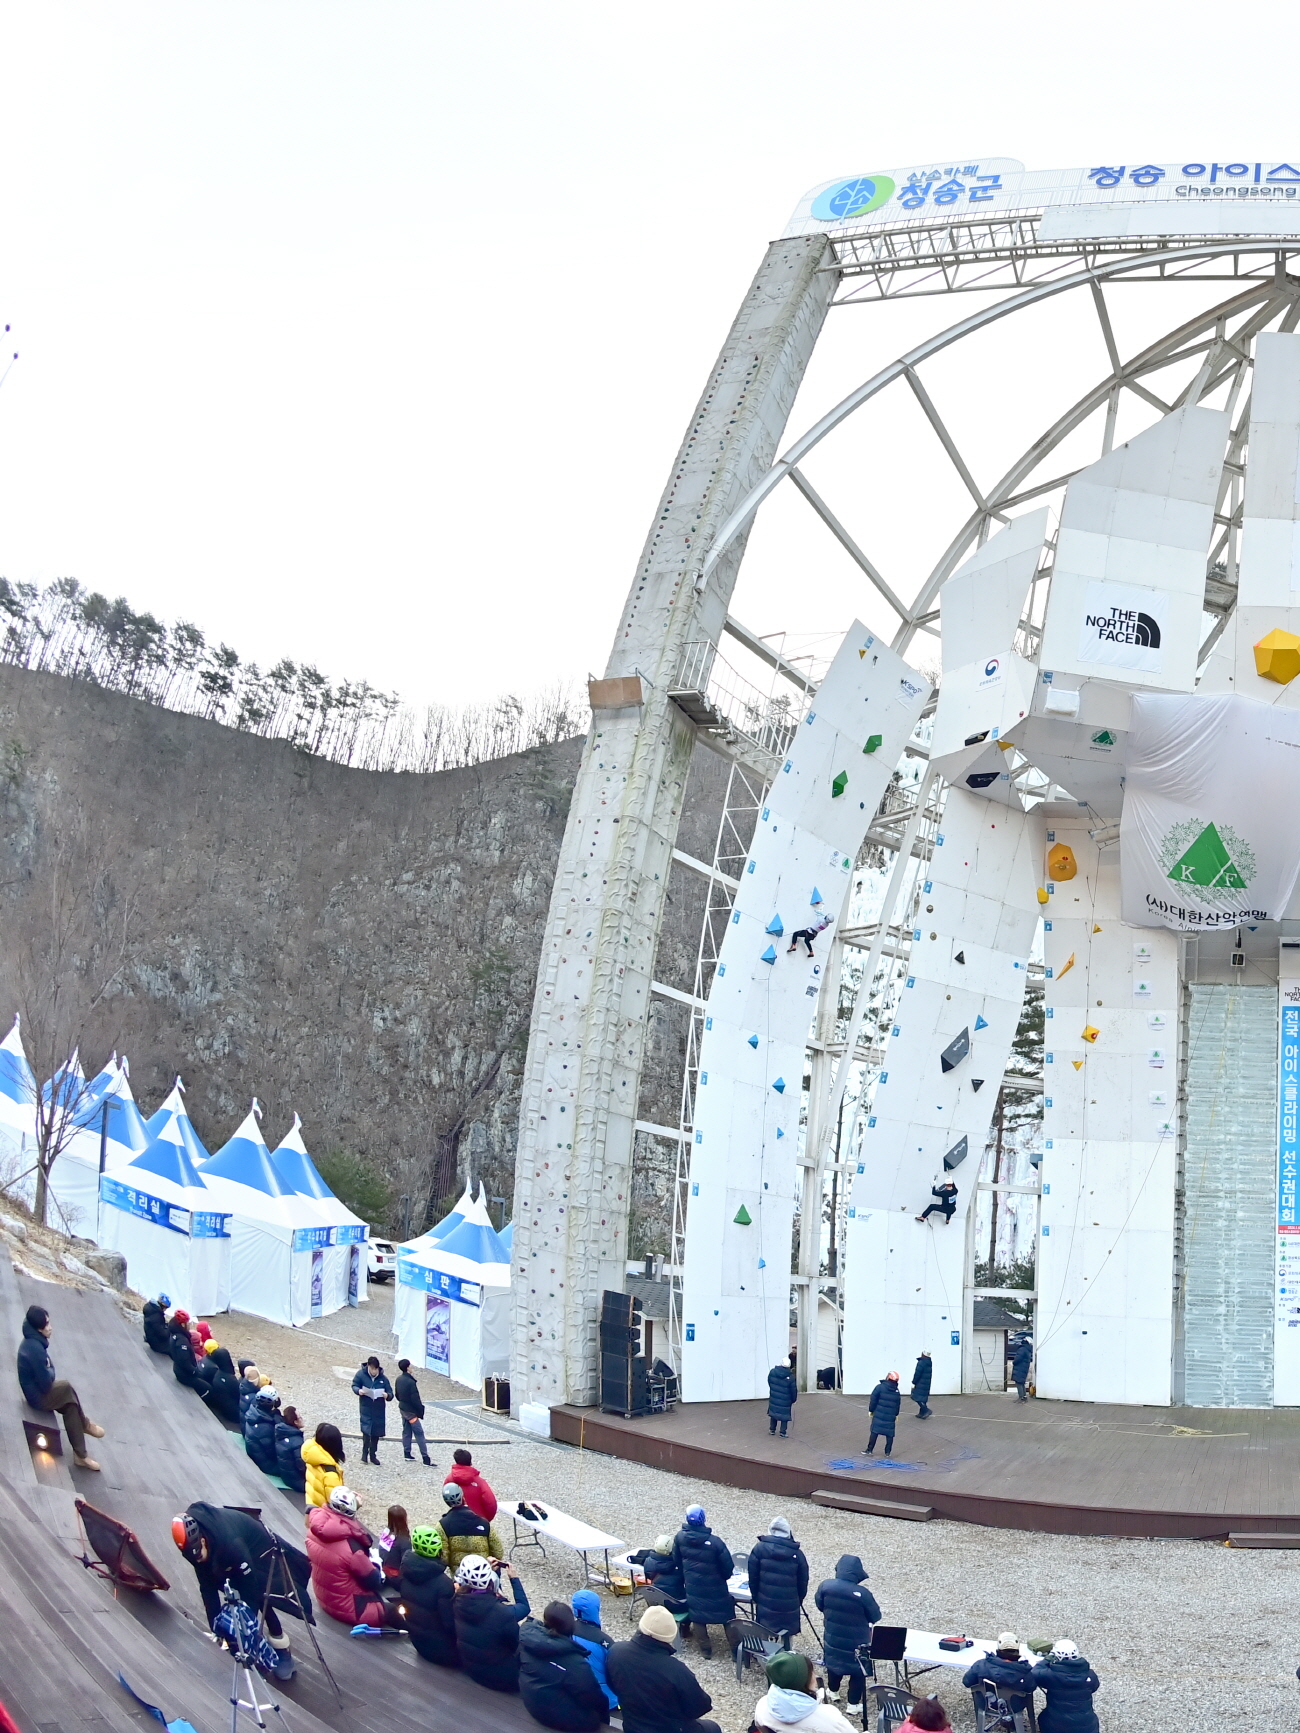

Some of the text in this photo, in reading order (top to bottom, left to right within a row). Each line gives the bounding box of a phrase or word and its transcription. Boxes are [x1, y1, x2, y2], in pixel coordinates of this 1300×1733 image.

[907, 165, 979, 182] 산소카페
[1088, 164, 1166, 188] 청송
[897, 174, 1002, 209] 청송군
[1176, 184, 1297, 198] Cheongsong
[1086, 614, 1136, 633] NORTH
[1110, 607, 1138, 622] THE
[1098, 628, 1134, 644] FACE
[1180, 864, 1238, 886] K F
[1146, 894, 1268, 926] (사)대한산악연맹
[1148, 908, 1173, 923] Korea
[1284, 1010, 1298, 1037] 전국
[1284, 1045, 1298, 1143] 아이스클라이밍
[1281, 1150, 1297, 1222] 선수권대회
[127, 1190, 160, 1215] 격리실
[424, 1270, 450, 1289] 심판
